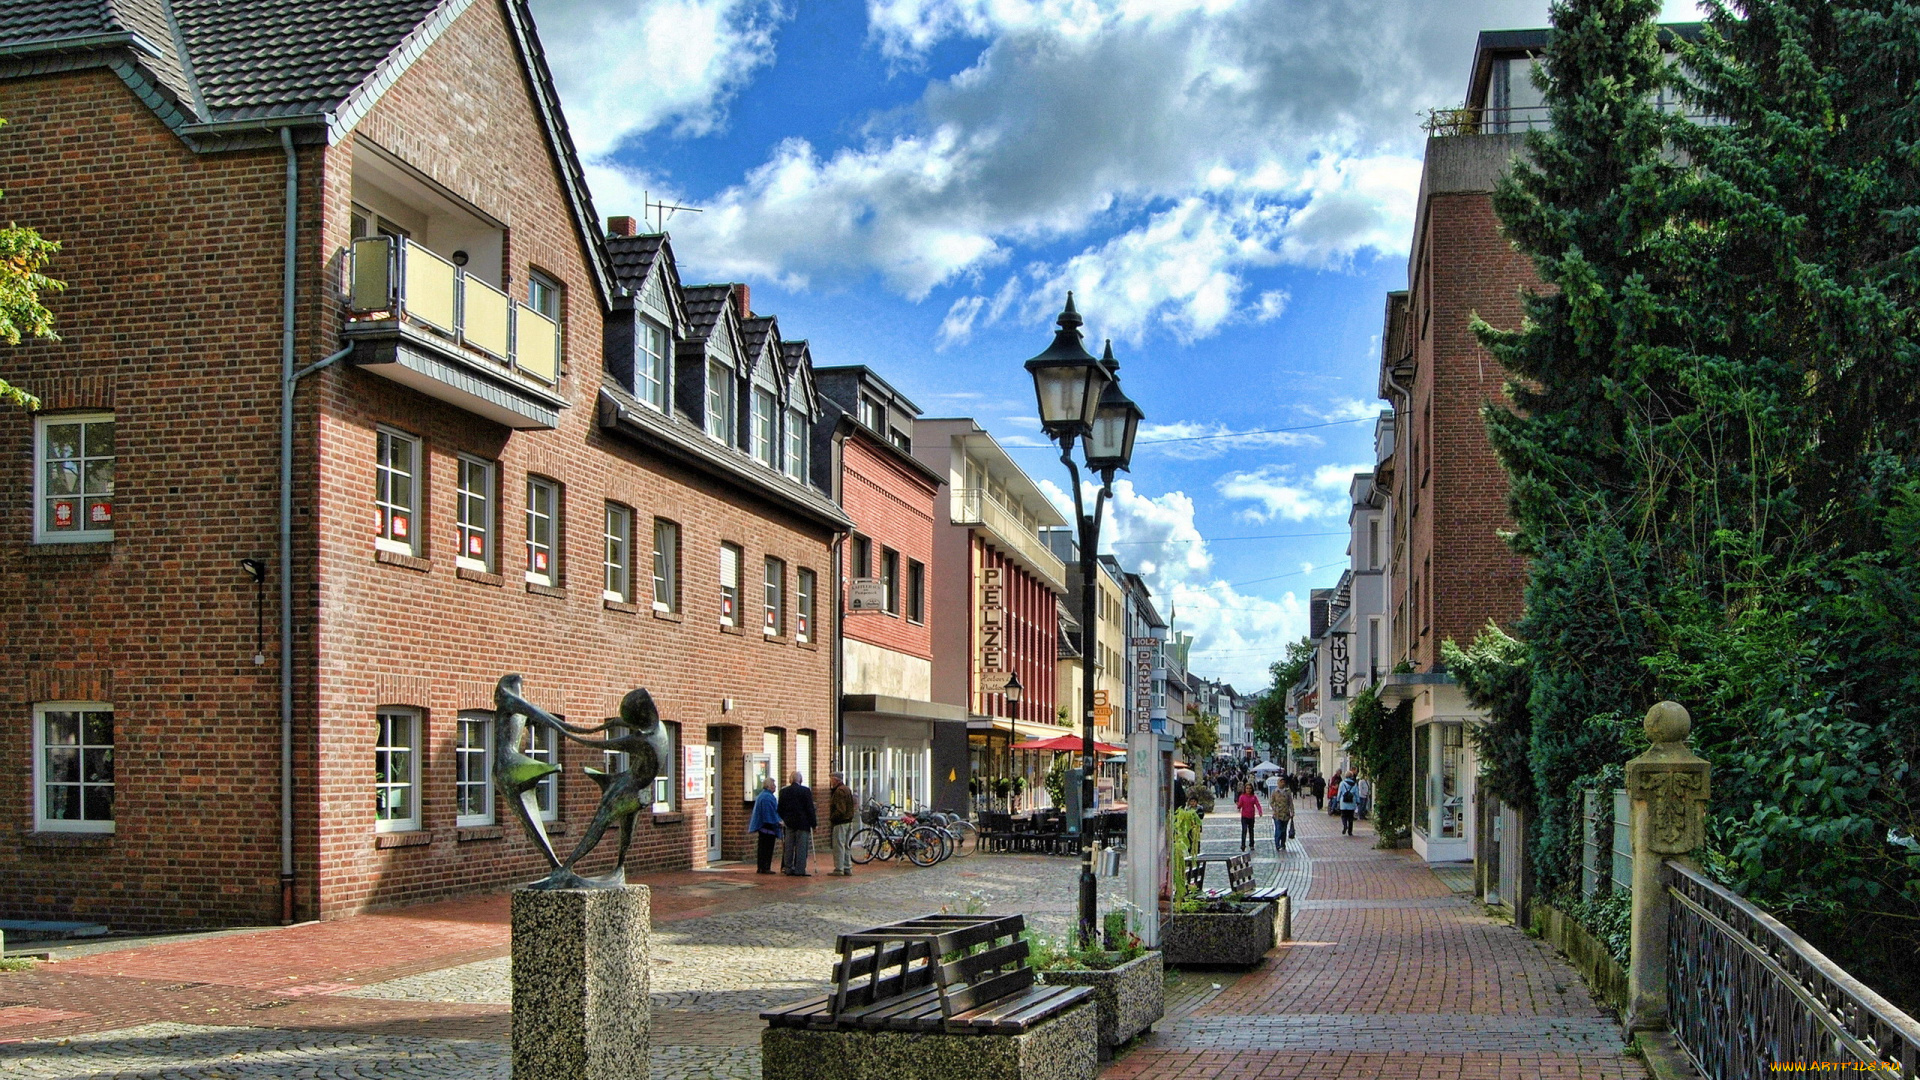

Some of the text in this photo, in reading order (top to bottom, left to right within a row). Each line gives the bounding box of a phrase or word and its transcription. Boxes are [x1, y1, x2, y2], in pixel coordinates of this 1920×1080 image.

[984, 569, 999, 667] PELZE
[1133, 638, 1156, 646] HOLZ
[1140, 651, 1150, 731] DAMMERS
[1333, 636, 1346, 694] KUNST
